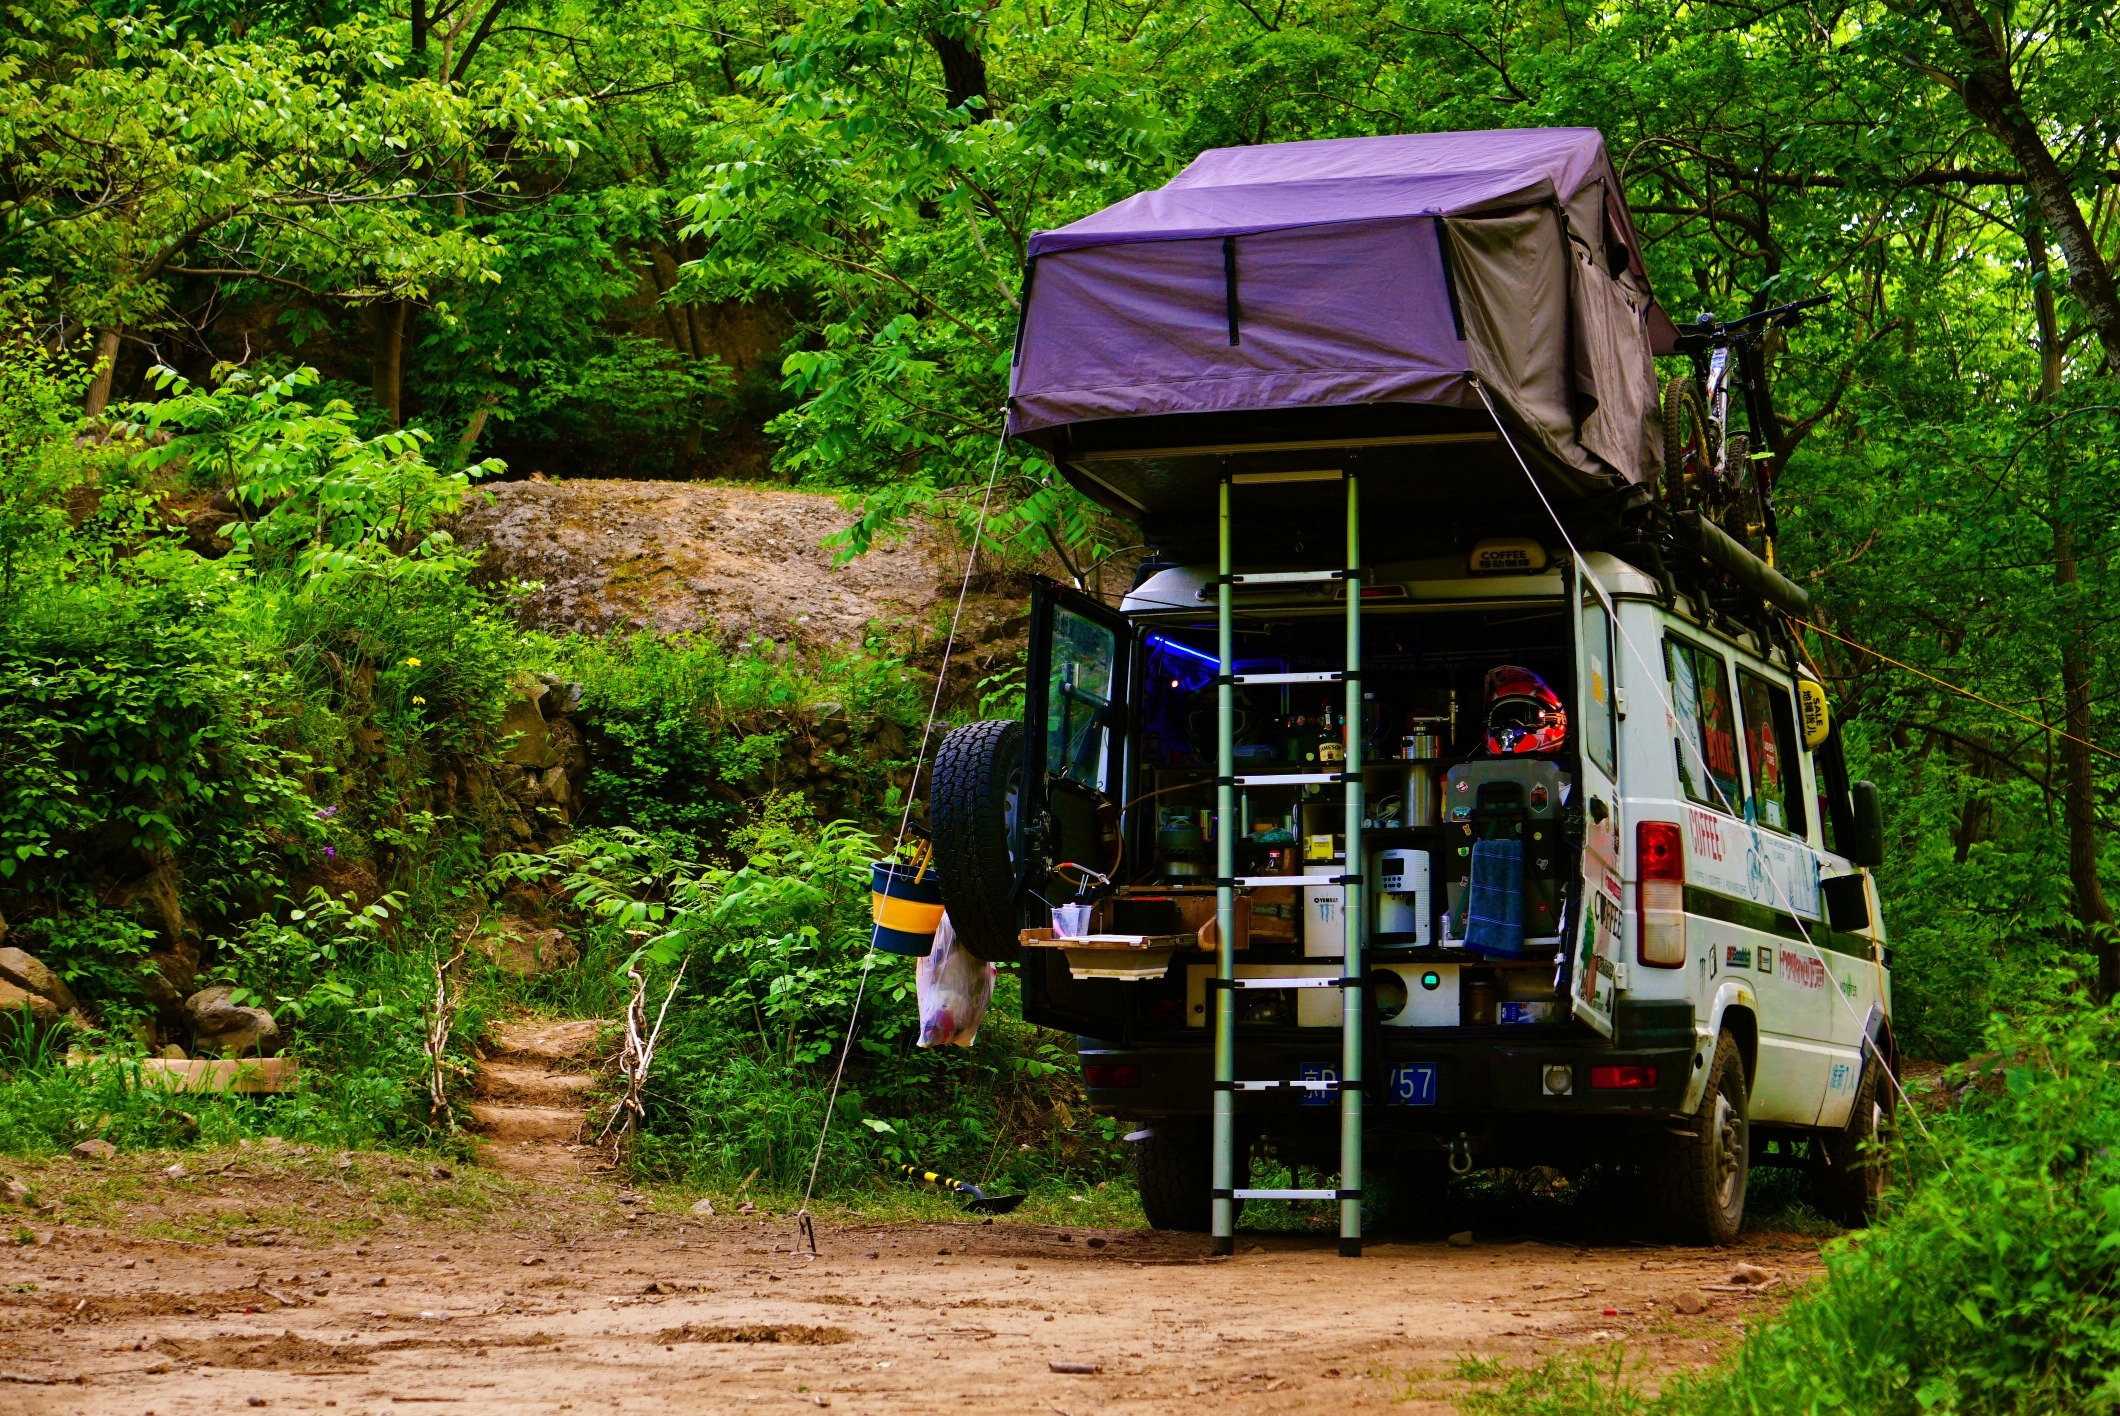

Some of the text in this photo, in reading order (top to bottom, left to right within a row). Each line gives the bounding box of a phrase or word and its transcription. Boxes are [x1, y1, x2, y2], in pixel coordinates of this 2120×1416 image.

[1481, 550, 1527, 560] COFFEE
[1813, 697, 1823, 726] SALE
[1689, 806, 1722, 862] COFFEE
